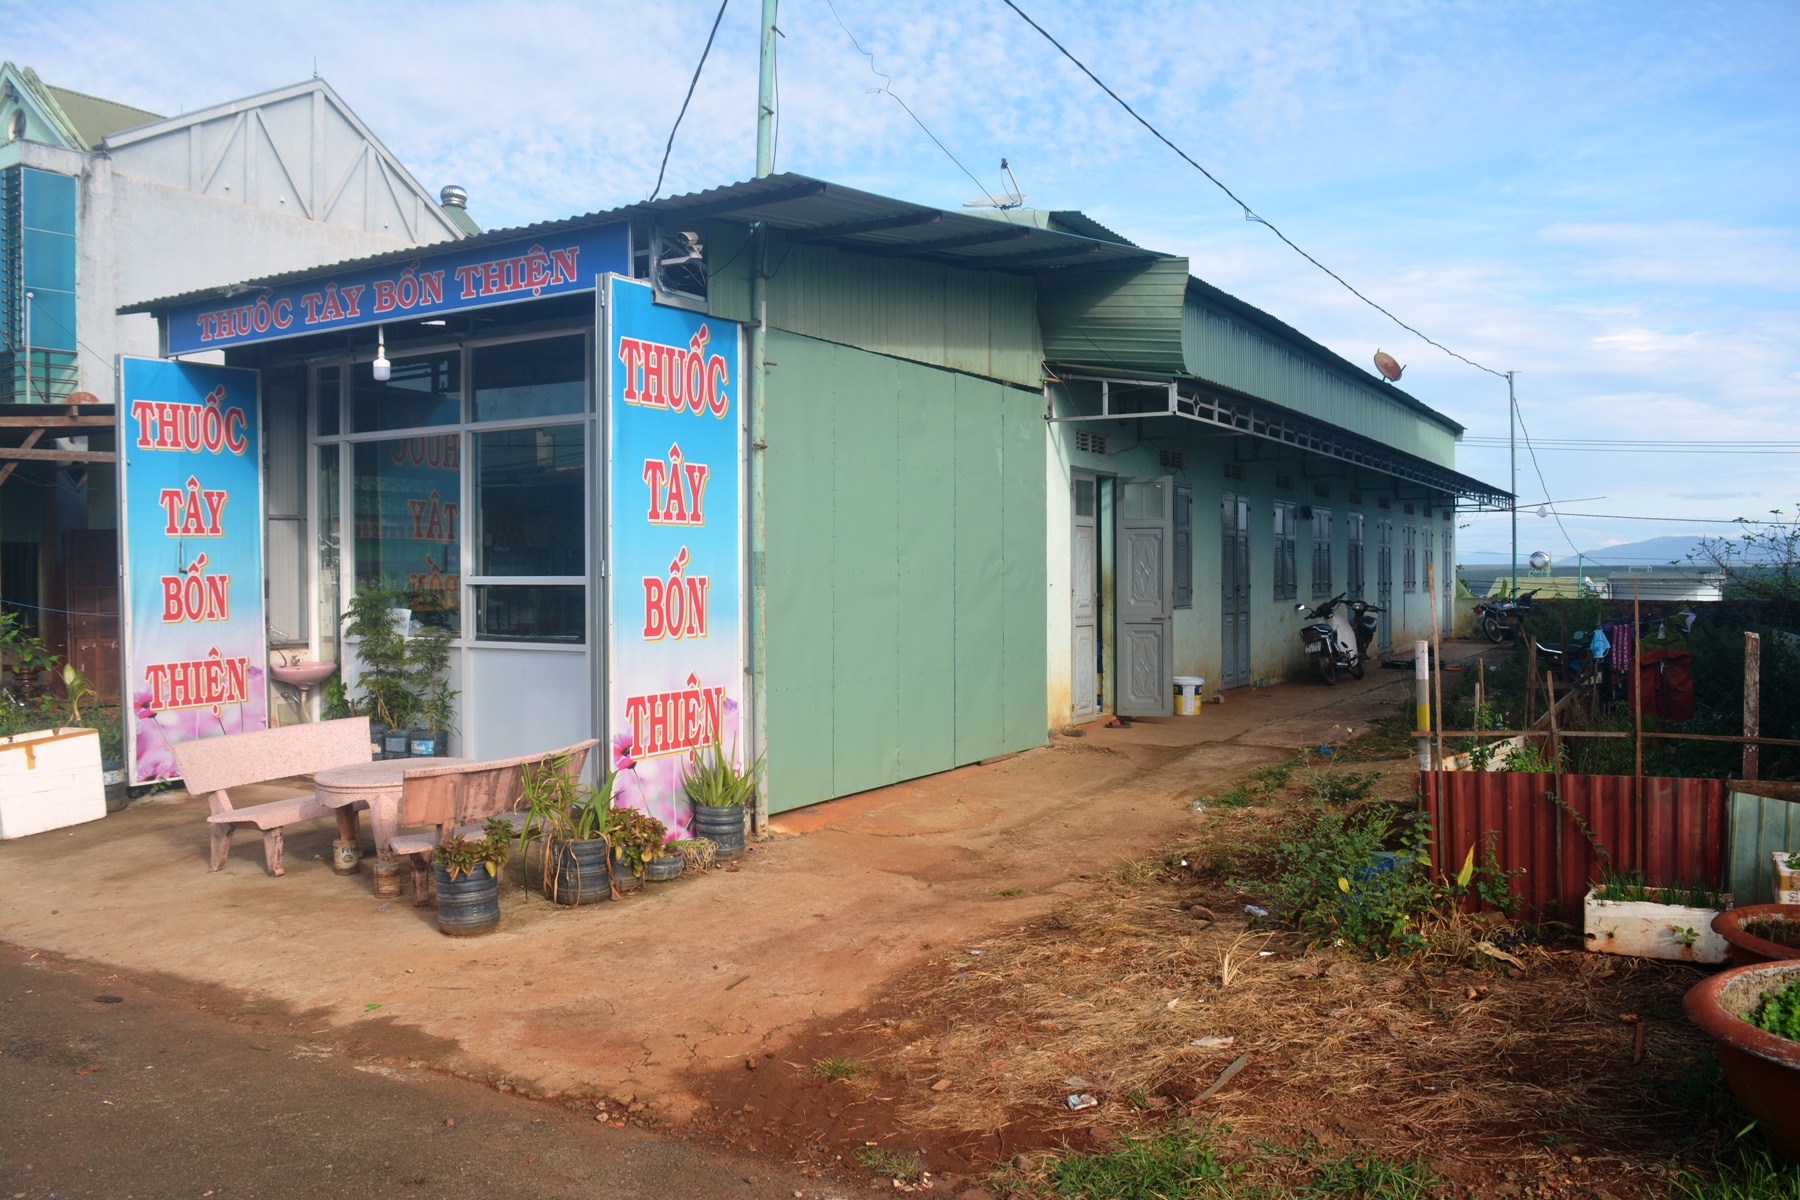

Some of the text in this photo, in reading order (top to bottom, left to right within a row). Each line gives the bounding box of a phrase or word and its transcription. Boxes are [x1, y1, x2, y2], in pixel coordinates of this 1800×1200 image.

[197, 244, 580, 342] THUỐC TÂY BỐN THIỆN
[618, 323, 729, 419] THUỐC
[130, 384, 249, 455] THUỐC
[158, 474, 229, 538] TÂY
[642, 442, 709, 526] TÂY
[159, 552, 230, 624] BỐN
[641, 545, 709, 641] BỐN
[145, 645, 250, 717] THIỆN
[625, 670, 726, 763] THIỆN
